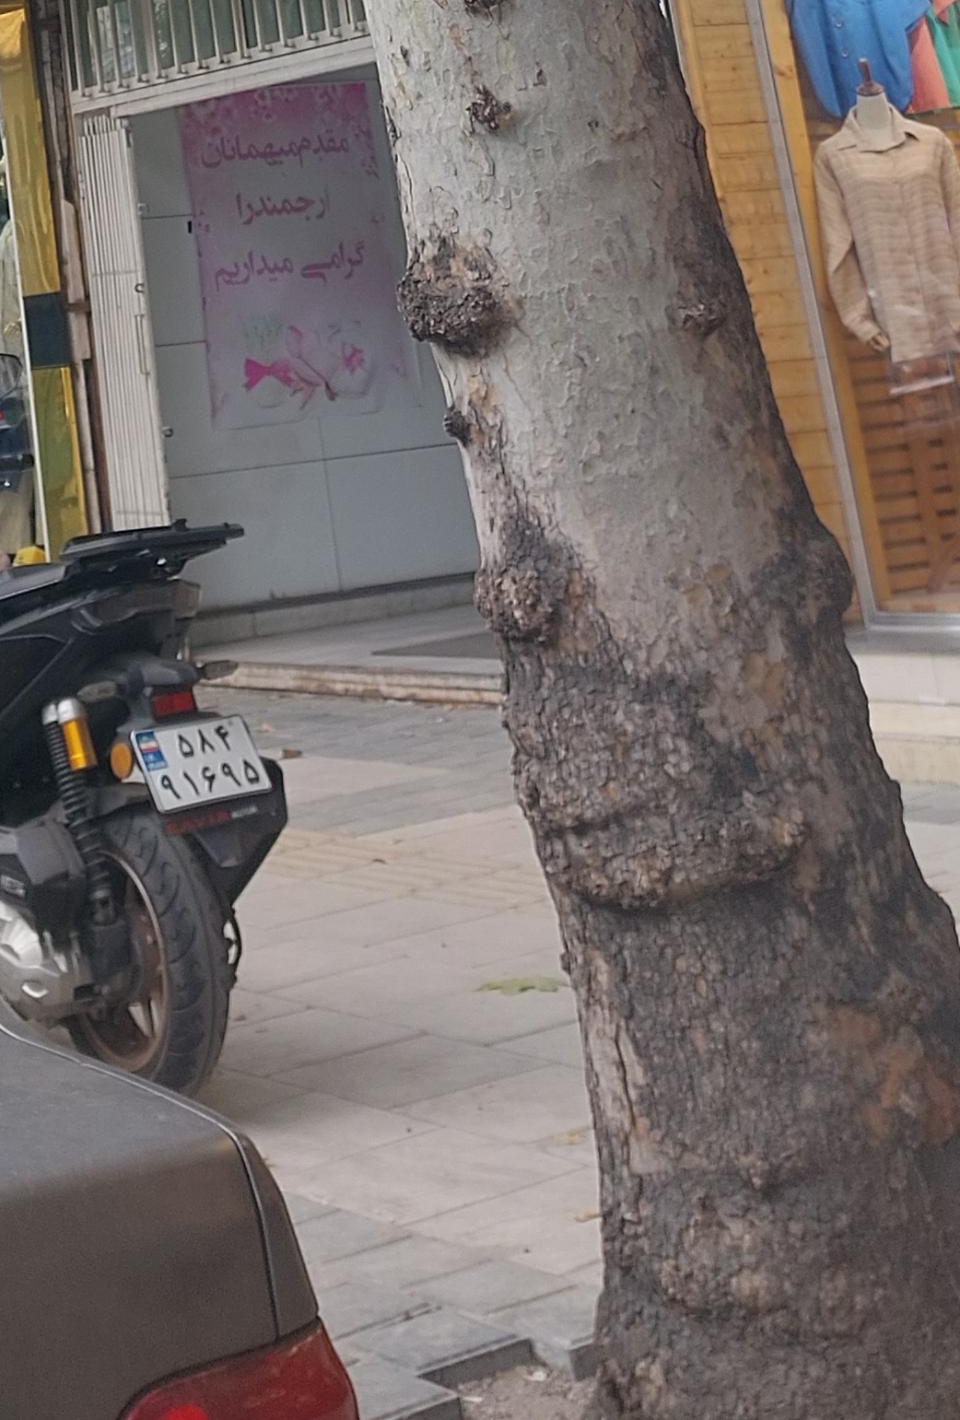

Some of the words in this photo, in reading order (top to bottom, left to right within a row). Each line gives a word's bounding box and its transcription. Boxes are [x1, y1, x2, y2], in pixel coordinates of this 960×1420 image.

[301, 240, 365, 283] گرامی
[178, 725, 231, 758] ۵۸۴
[161, 759, 260, 799] ۹۱۶۹۵
